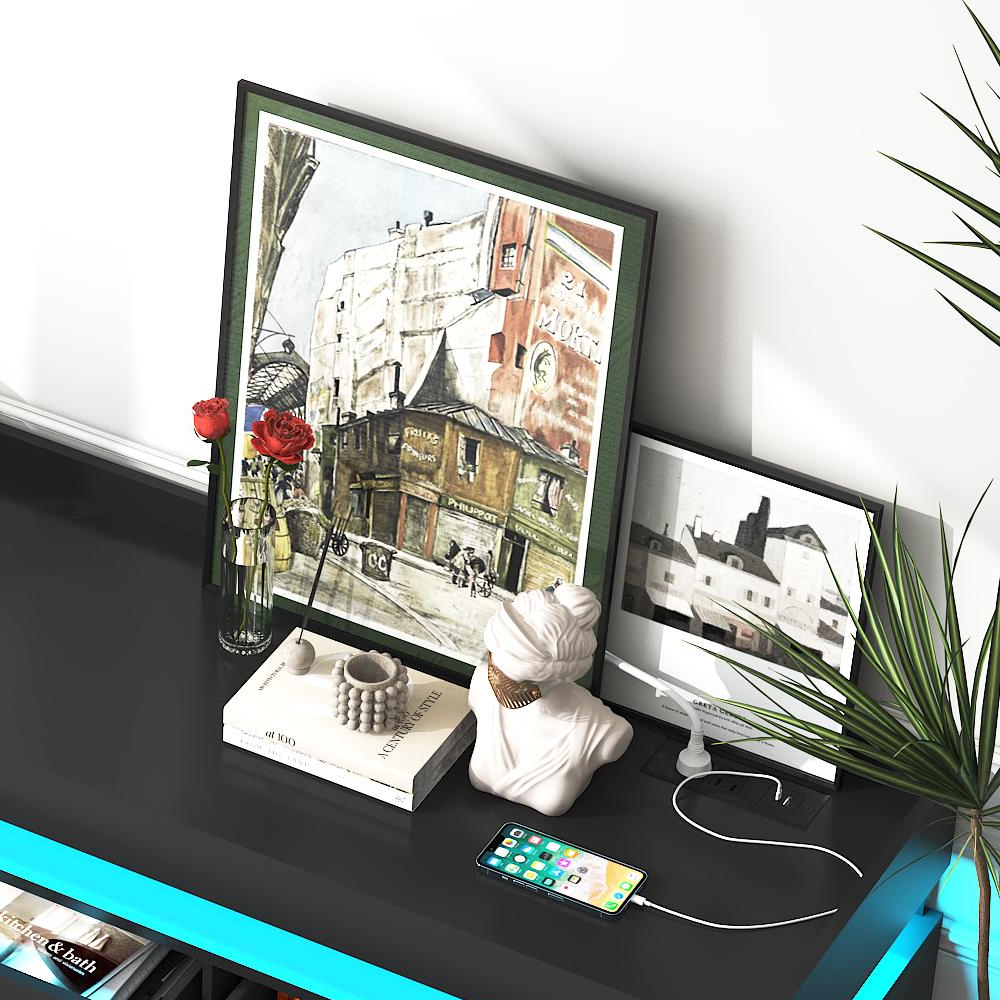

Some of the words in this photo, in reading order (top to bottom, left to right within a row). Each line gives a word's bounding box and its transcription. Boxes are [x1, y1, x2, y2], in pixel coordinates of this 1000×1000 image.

[404, 426, 440, 445] FRUITS
[368, 552, 387, 572] CC
[383, 719, 416, 753] CENTURY
[411, 709, 424, 722] OF
[419, 690, 443, 712] STYLE
[265, 731, 275, 739] at
[277, 732, 296, 747] 100
[47, 941, 65, 954] &
[62, 947, 97, 974] bath
